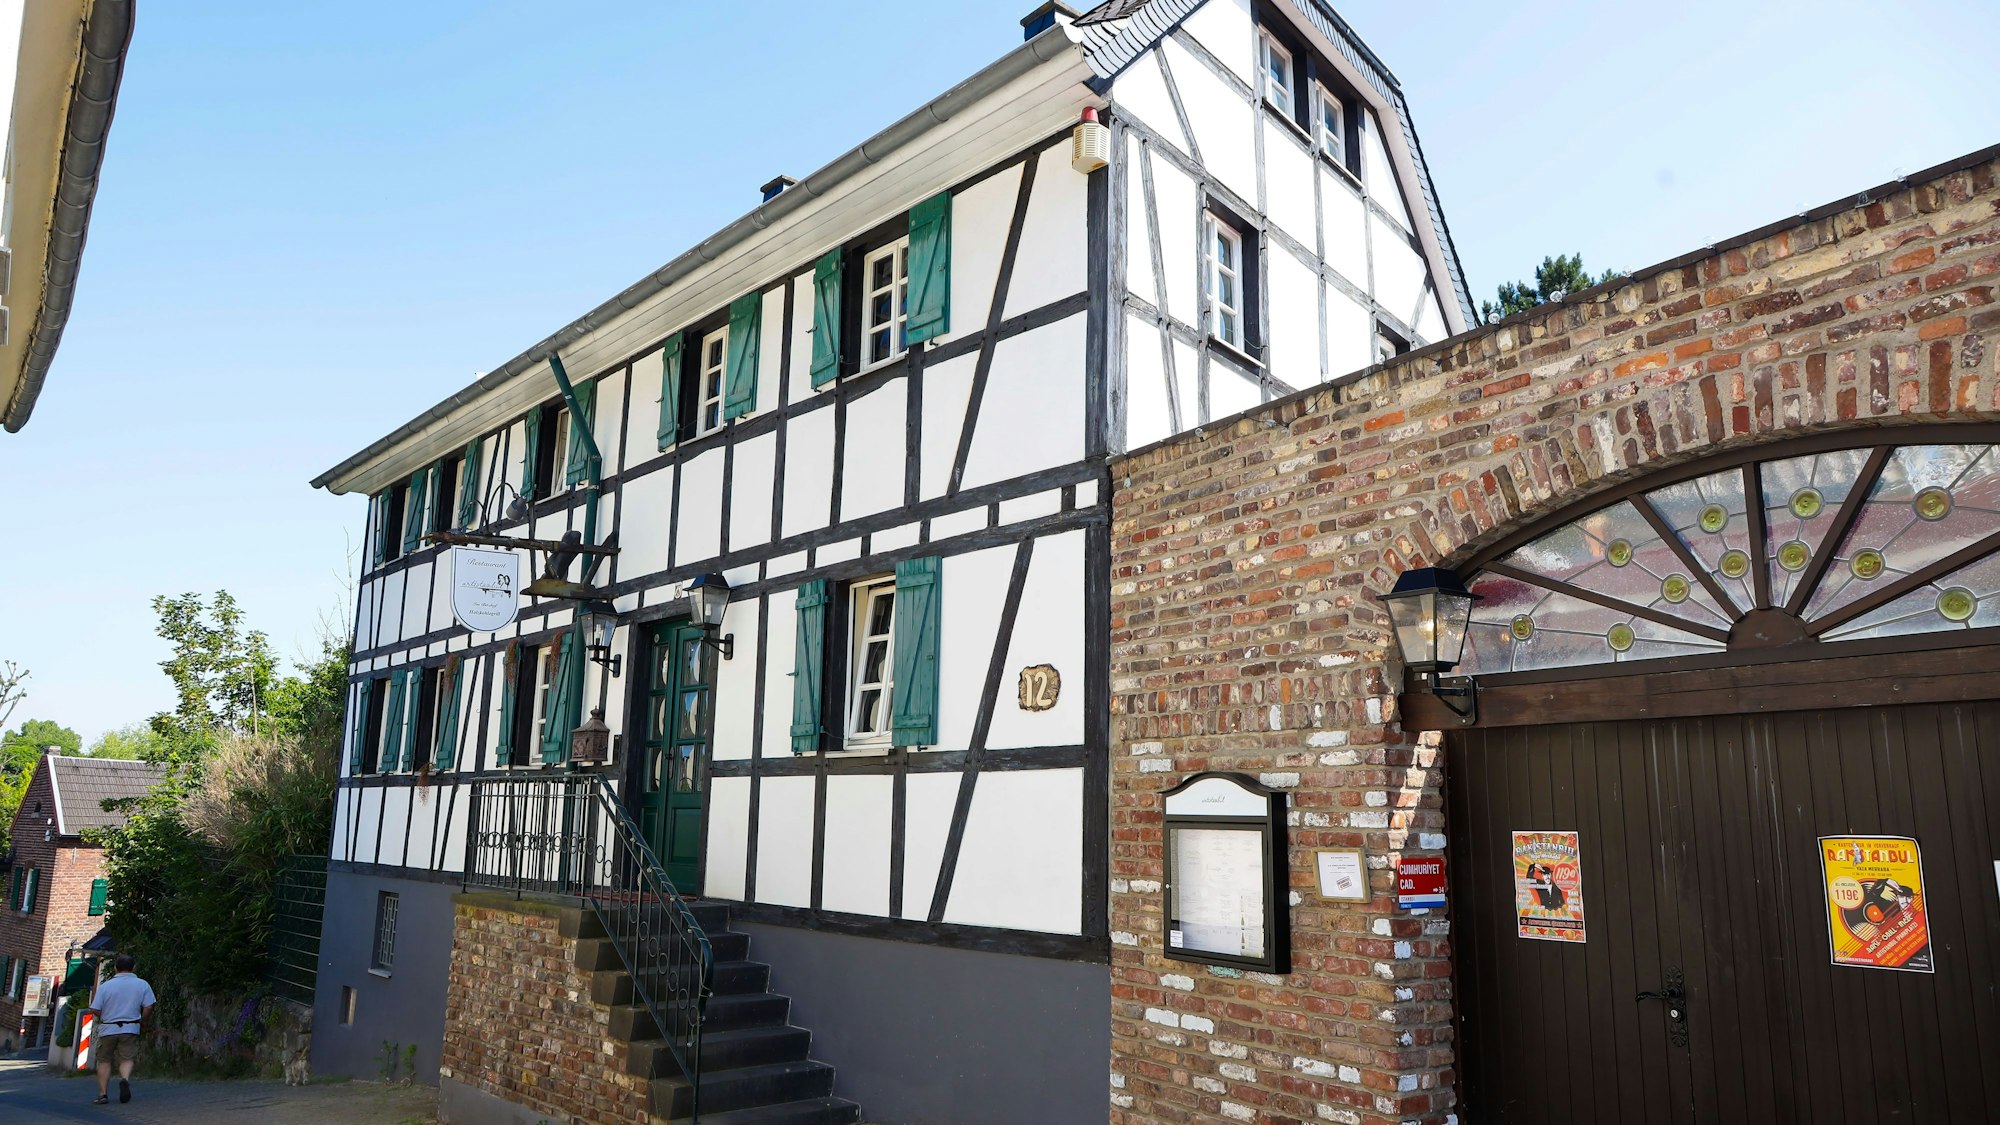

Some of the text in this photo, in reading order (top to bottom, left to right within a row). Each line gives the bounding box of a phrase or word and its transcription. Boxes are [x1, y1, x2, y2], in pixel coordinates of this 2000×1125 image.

[467, 558, 506, 568] Restaurant
[1024, 671, 1052, 707] 12
[1399, 862, 1440, 875] CUMHURİYET
[1400, 879, 1415, 890] CAD.
[1835, 889, 1859, 901] 119€
